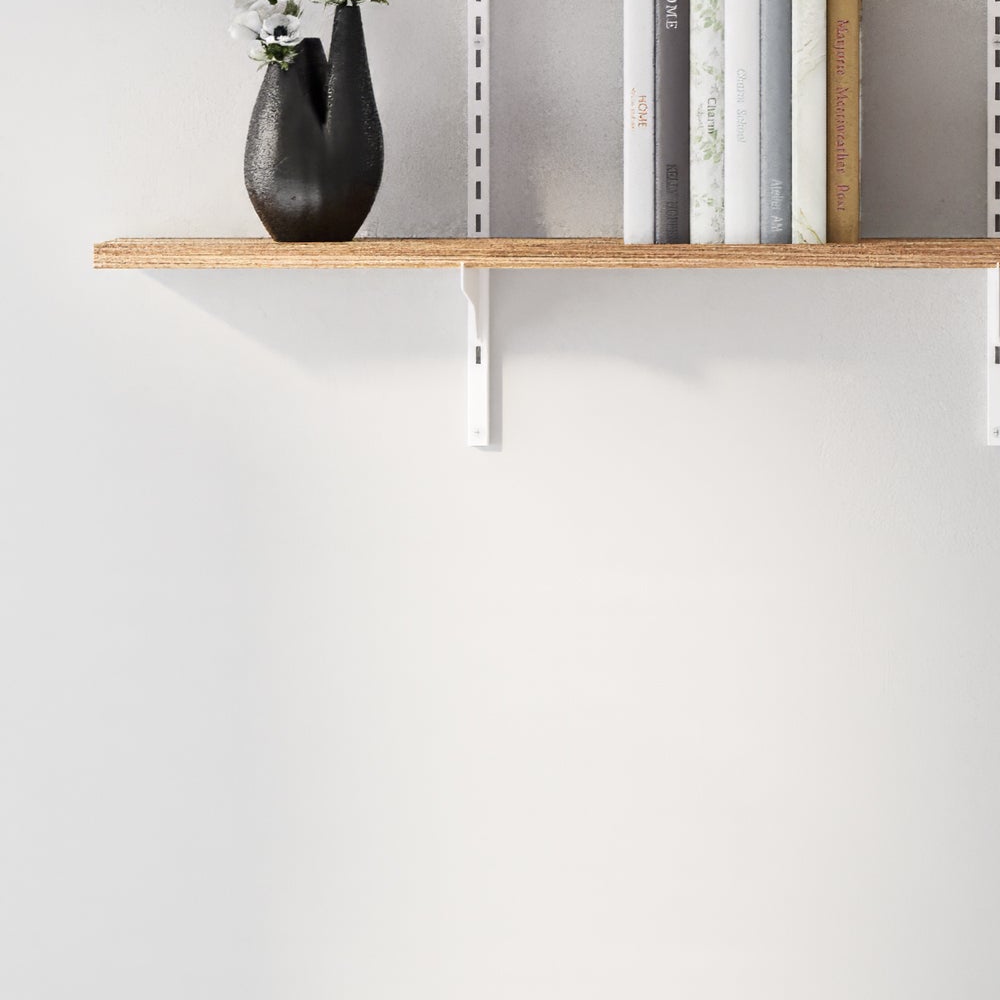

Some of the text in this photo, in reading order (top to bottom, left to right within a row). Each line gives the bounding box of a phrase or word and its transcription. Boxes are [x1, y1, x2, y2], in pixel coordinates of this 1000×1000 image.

[637, 95, 647, 128] HOME
[706, 98, 717, 135] Charm
[836, 184, 849, 212] Post
